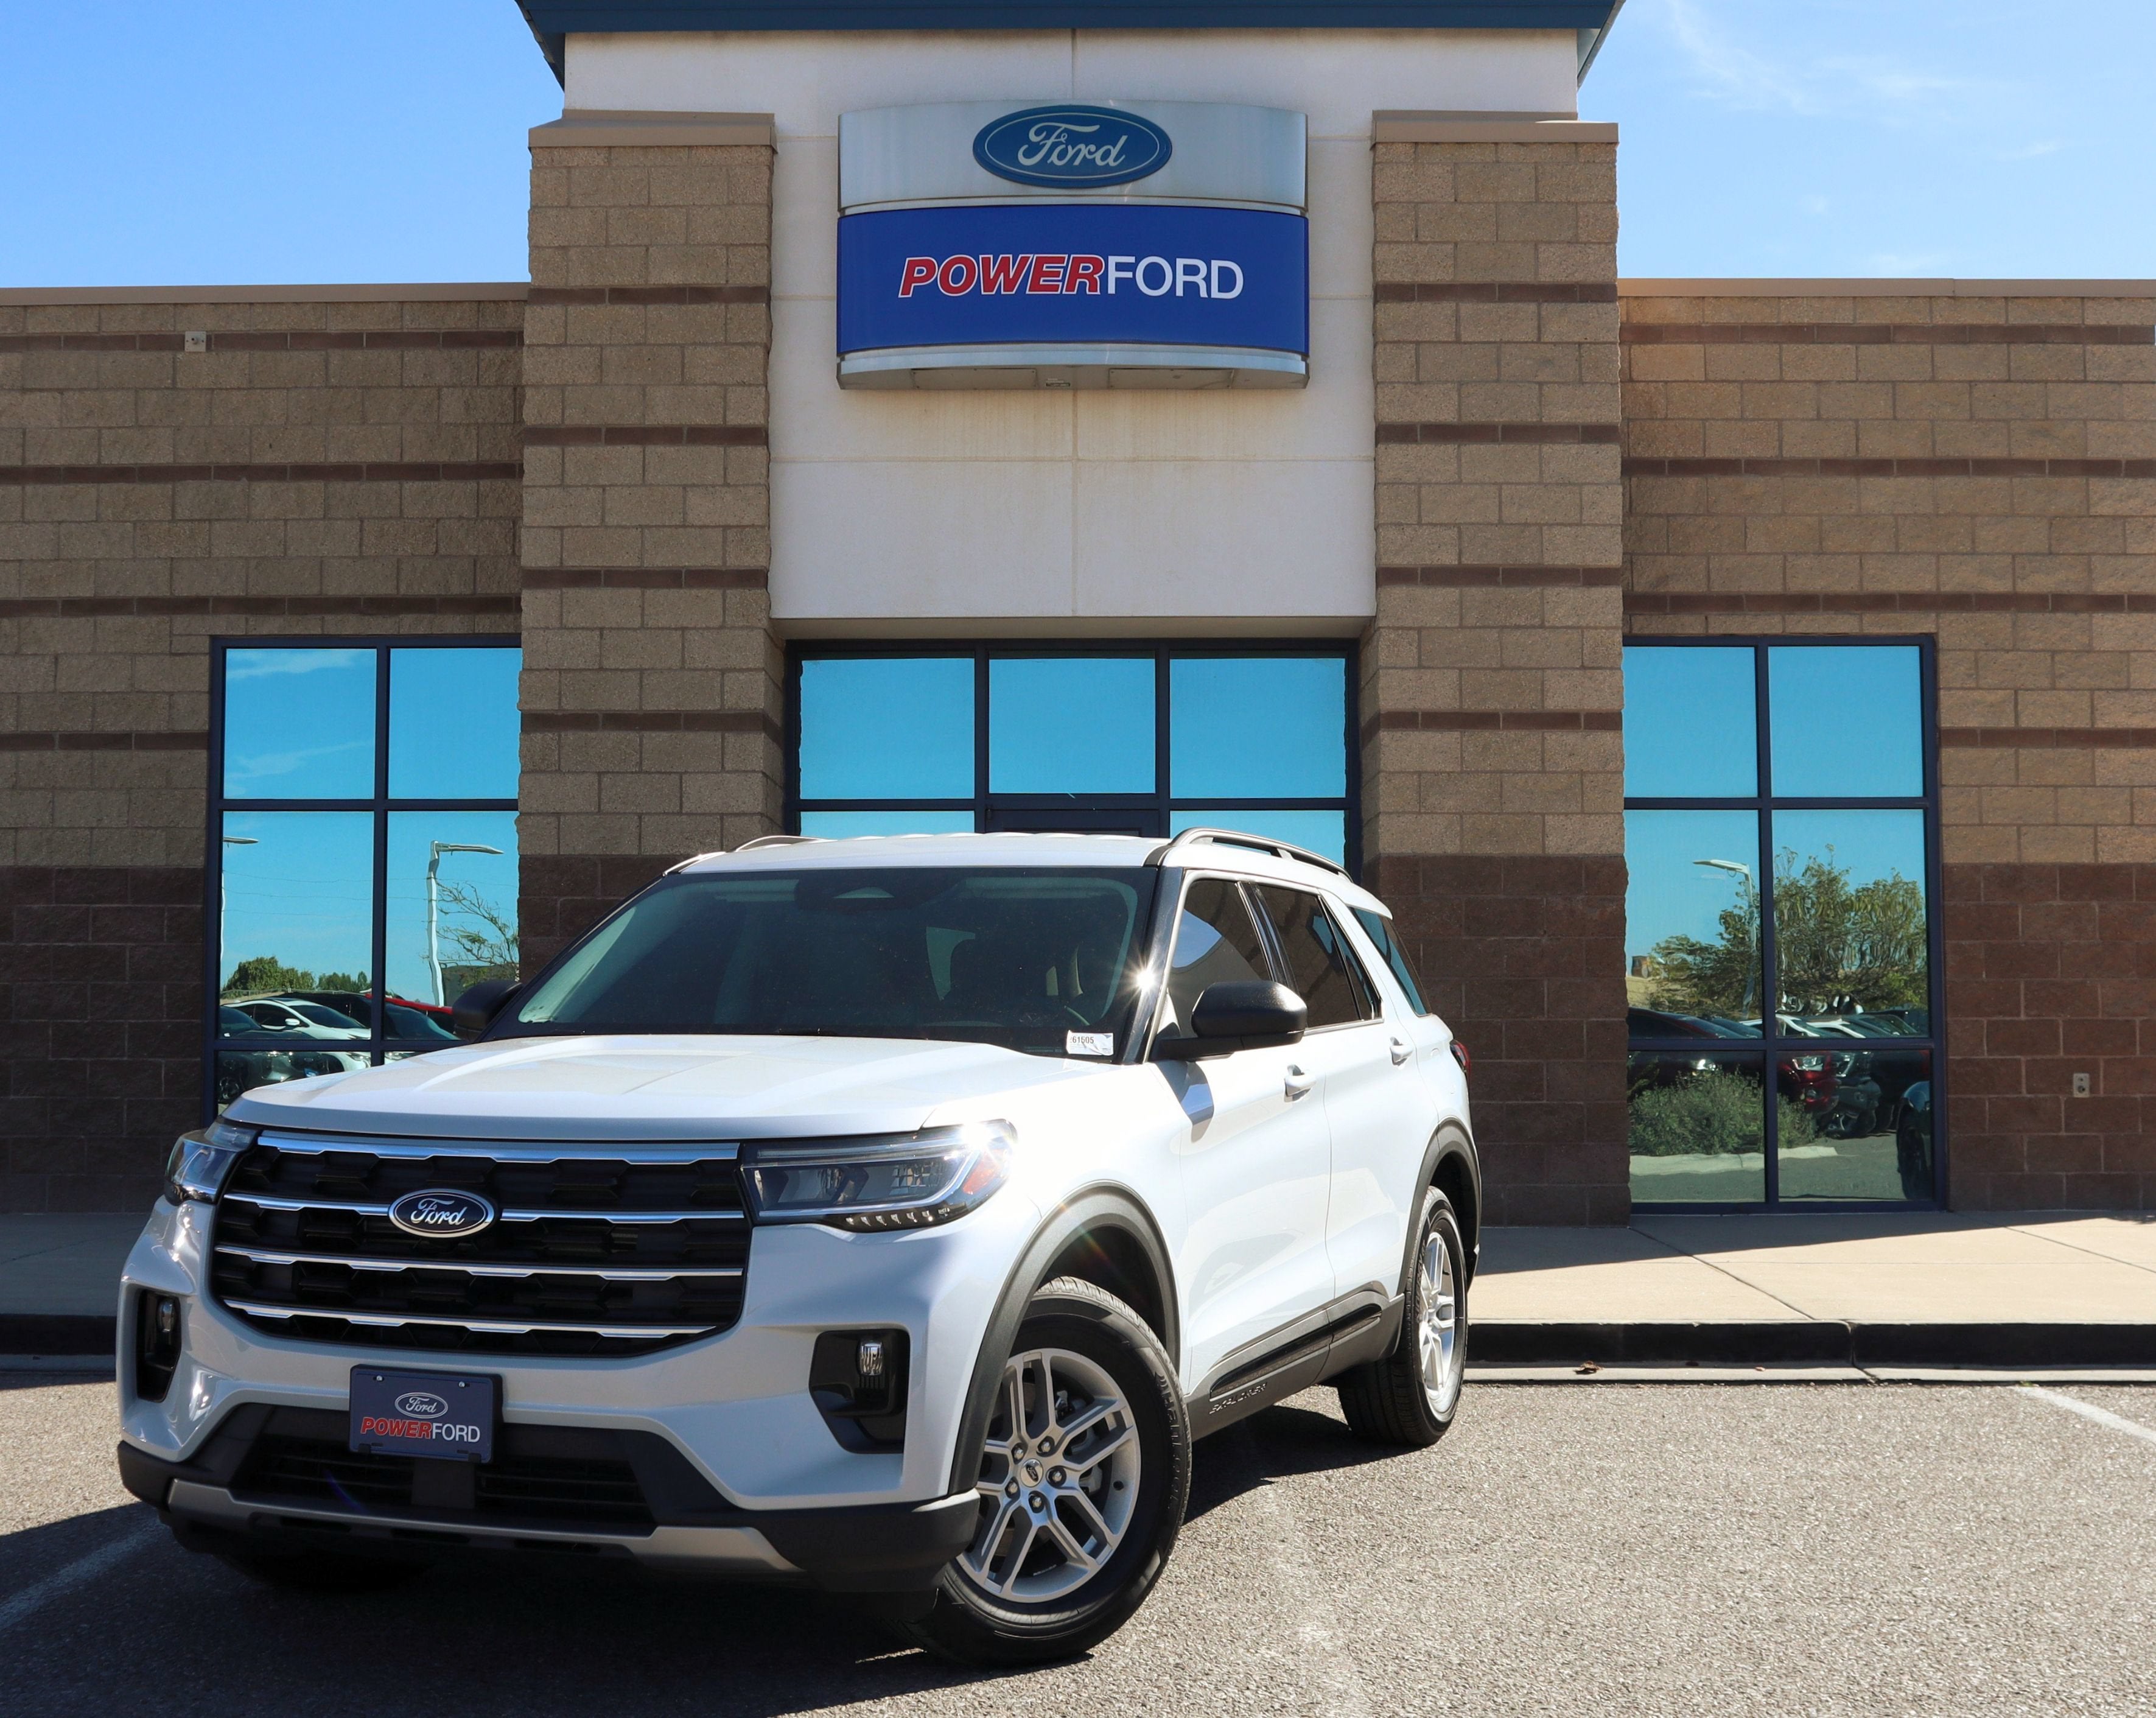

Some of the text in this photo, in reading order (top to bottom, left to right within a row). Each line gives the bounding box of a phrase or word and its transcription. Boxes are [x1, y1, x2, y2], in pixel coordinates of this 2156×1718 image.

[1018, 122, 1127, 167] Ford
[898, 254, 1244, 299] POWERFORD
[411, 1198, 467, 1225] Ford
[405, 1396, 437, 1413] Ford
[360, 1417, 480, 1442] POWERFORD
